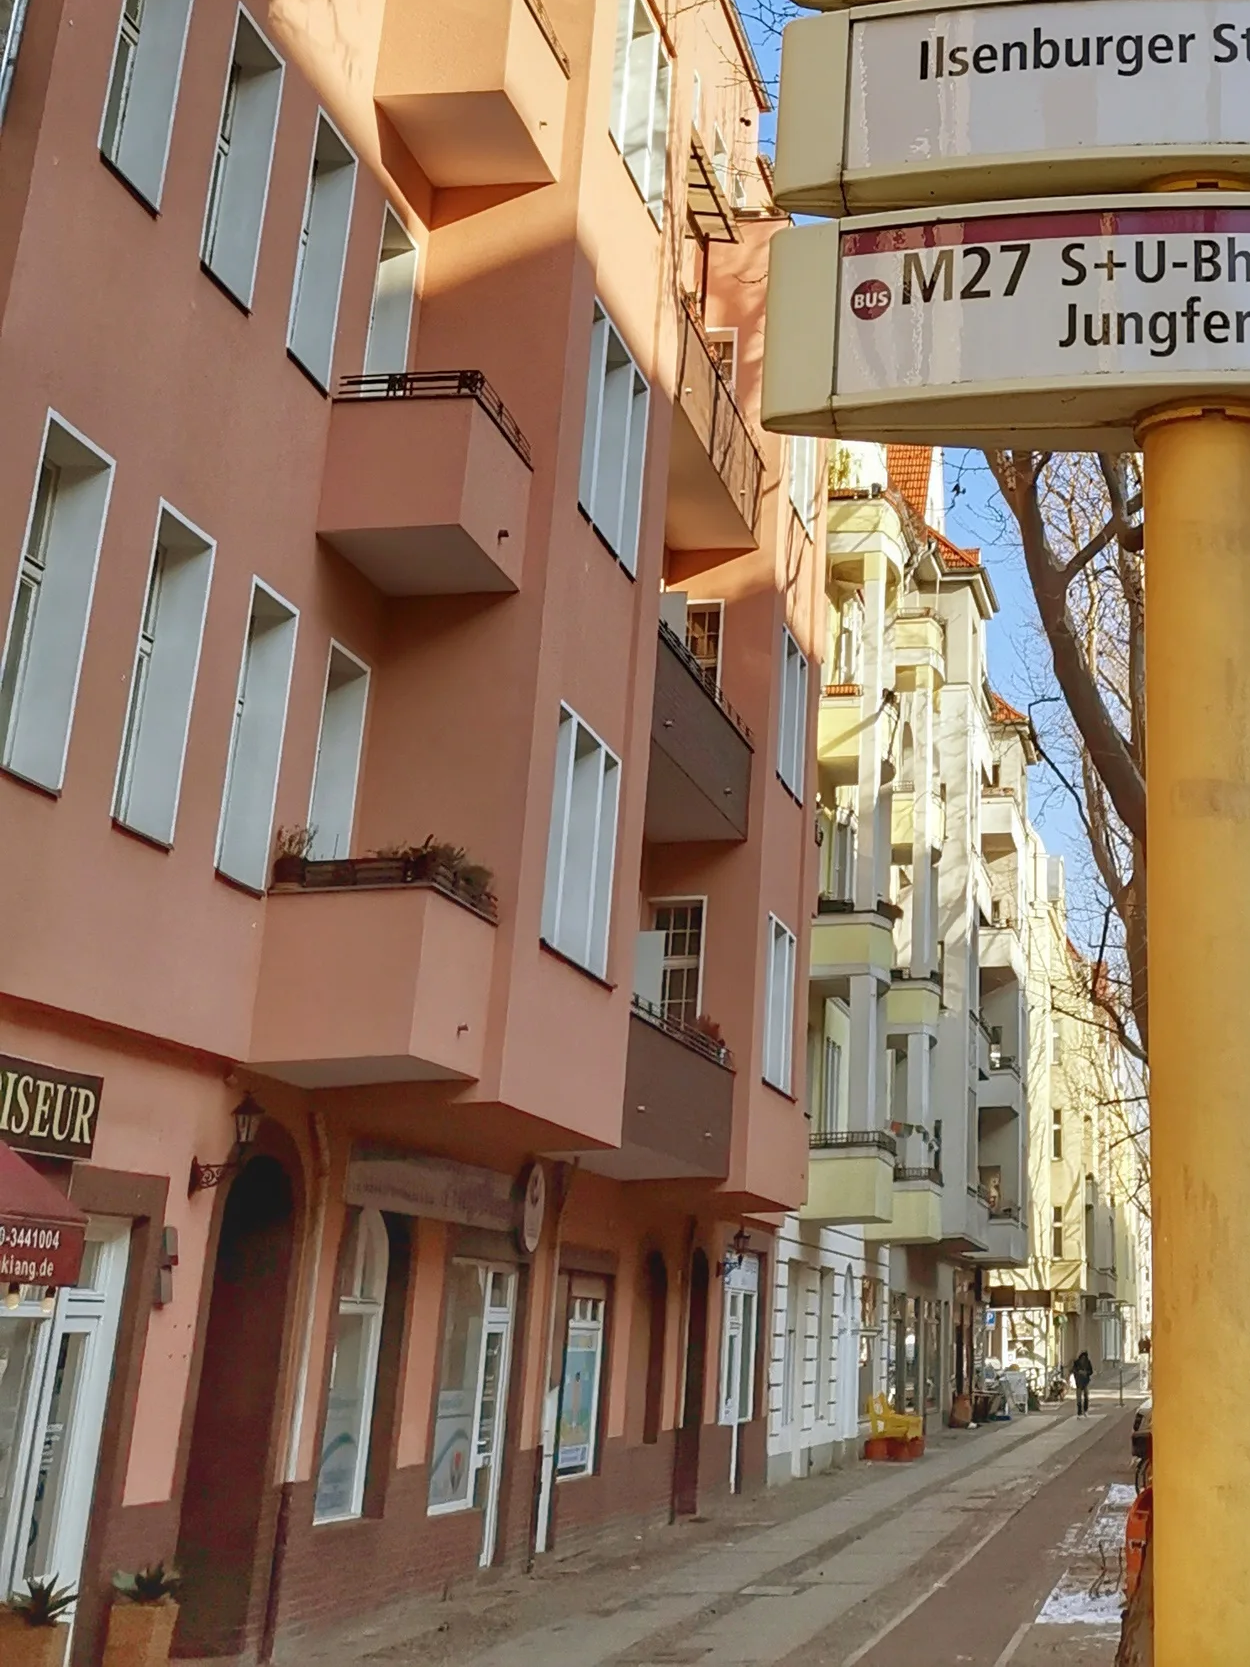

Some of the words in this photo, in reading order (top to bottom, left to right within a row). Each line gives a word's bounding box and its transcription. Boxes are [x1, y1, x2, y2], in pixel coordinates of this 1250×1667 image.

[919, 27, 1195, 80] Ilsenburger
[854, 290, 889, 309] BUS
[902, 243, 1031, 305] M27
[0, 1071, 96, 1144] ISEUR
[0, 1254, 54, 1281] kiang.de
